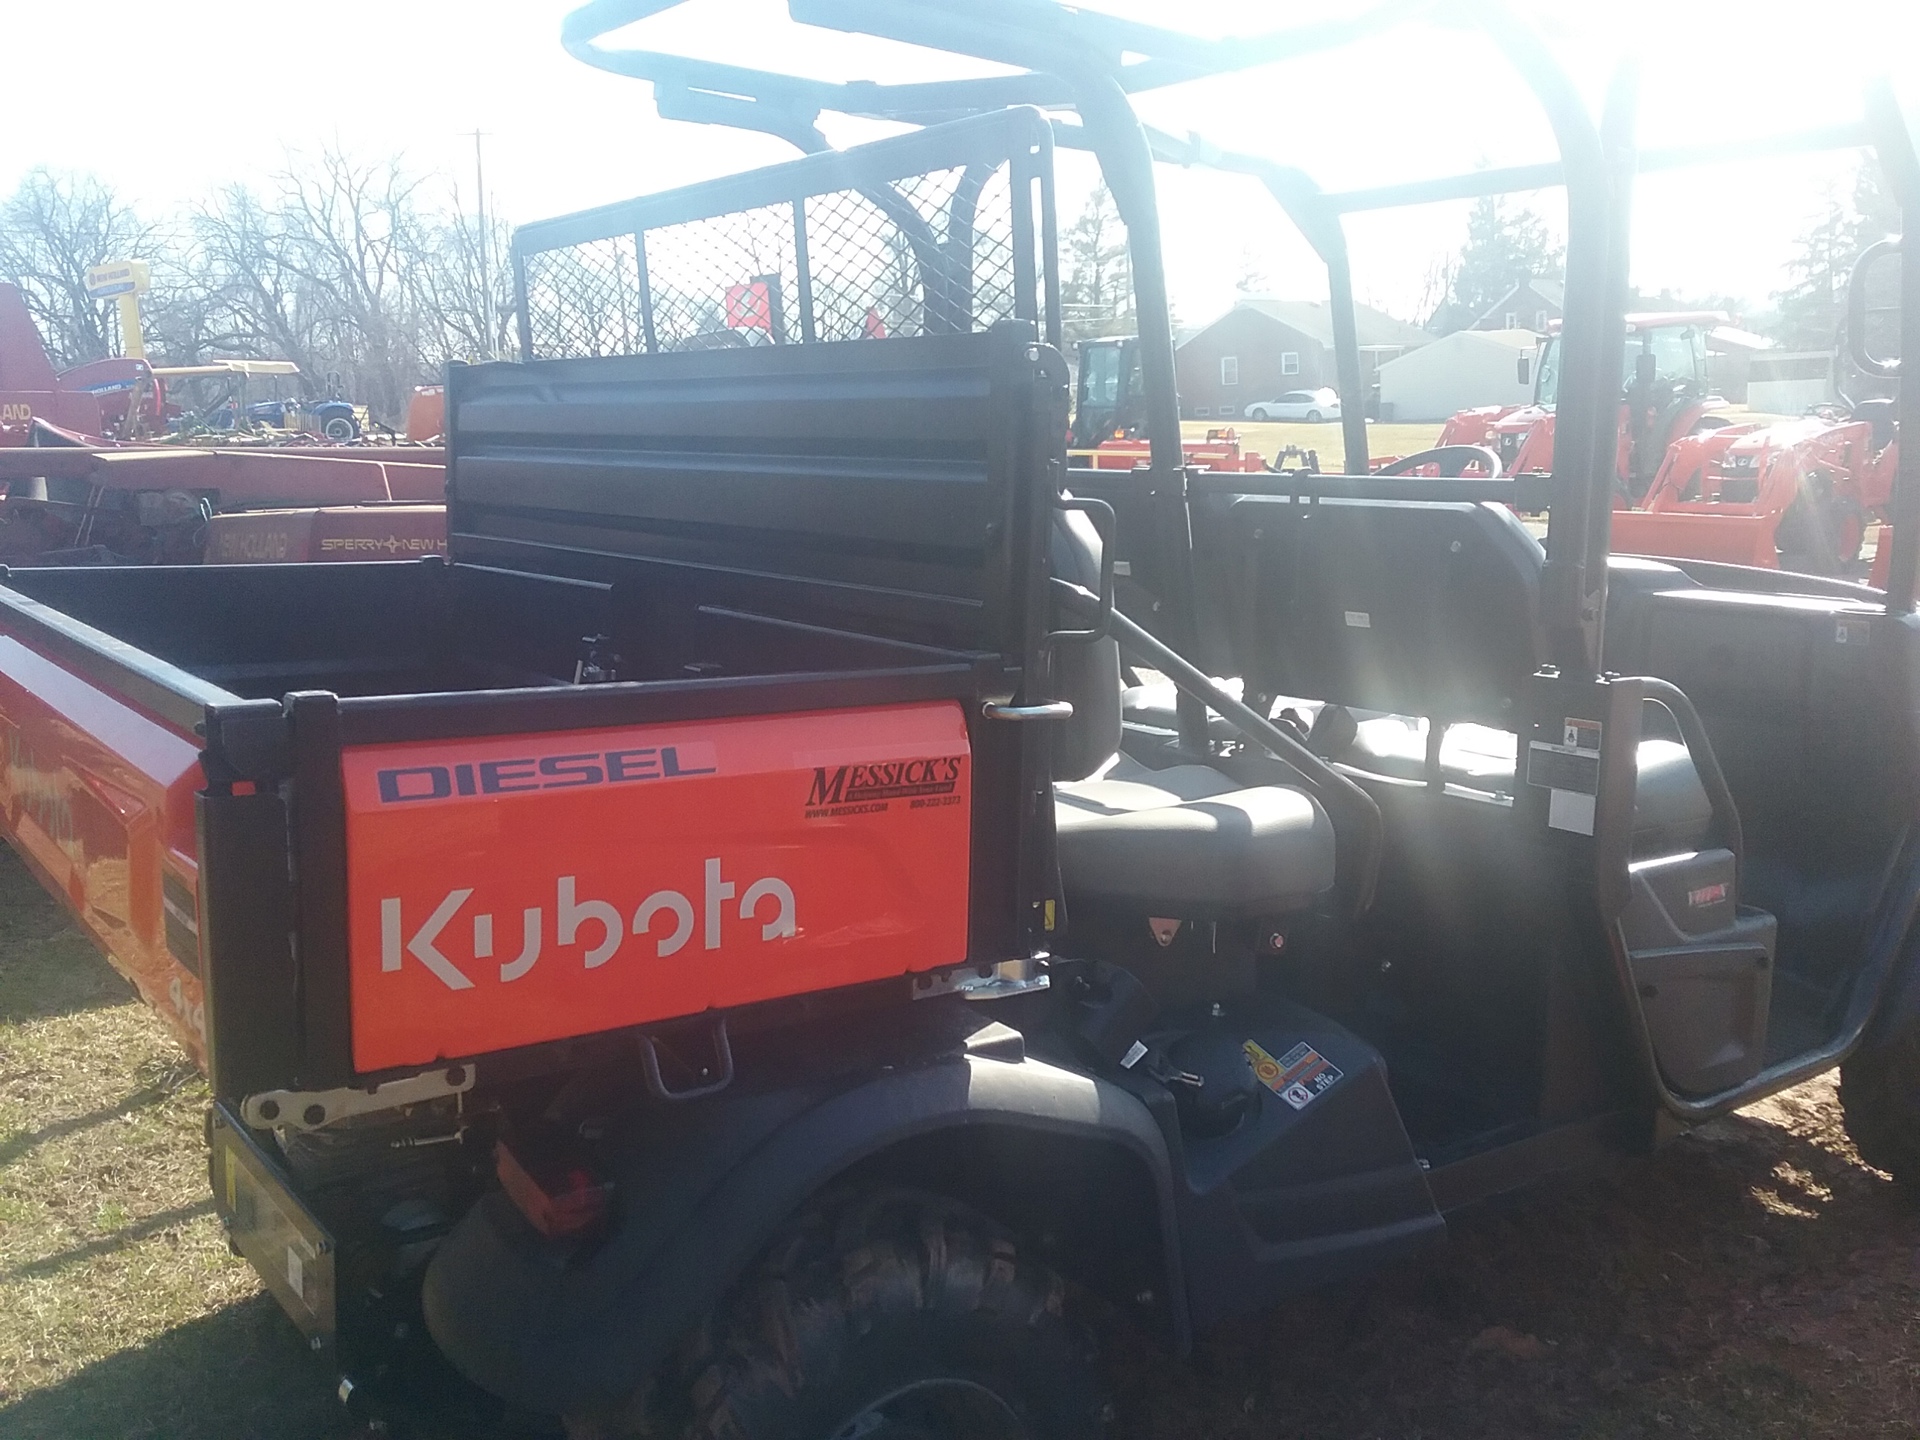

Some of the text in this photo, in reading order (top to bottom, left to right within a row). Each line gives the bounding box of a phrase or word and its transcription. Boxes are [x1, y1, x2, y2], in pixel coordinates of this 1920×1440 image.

[0, 404, 31, 420] AND
[321, 538, 383, 550] SPERRY
[402, 538, 434, 550] NEW
[376, 746, 717, 804] DIESEL
[805, 756, 962, 807] MESSICK'S
[804, 803, 889, 819] WWW.MESSICKS.COM
[381, 858, 797, 991] Kubota
[1313, 1072, 1326, 1083] NO
[1316, 1074, 1334, 1091] STEP
